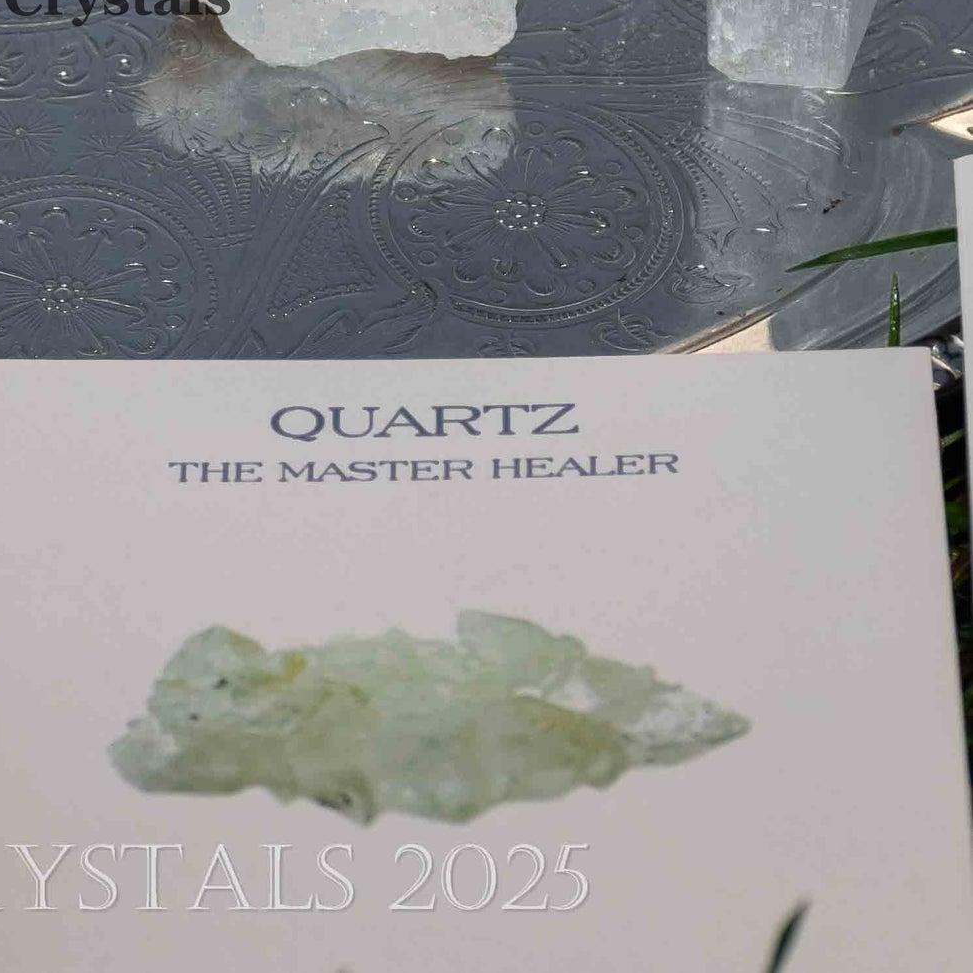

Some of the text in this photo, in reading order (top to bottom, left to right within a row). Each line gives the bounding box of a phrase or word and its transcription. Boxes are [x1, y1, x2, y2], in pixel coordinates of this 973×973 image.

[270, 403, 579, 442] QUARTZ
[169, 453, 679, 483] THE MASTER HEALER
